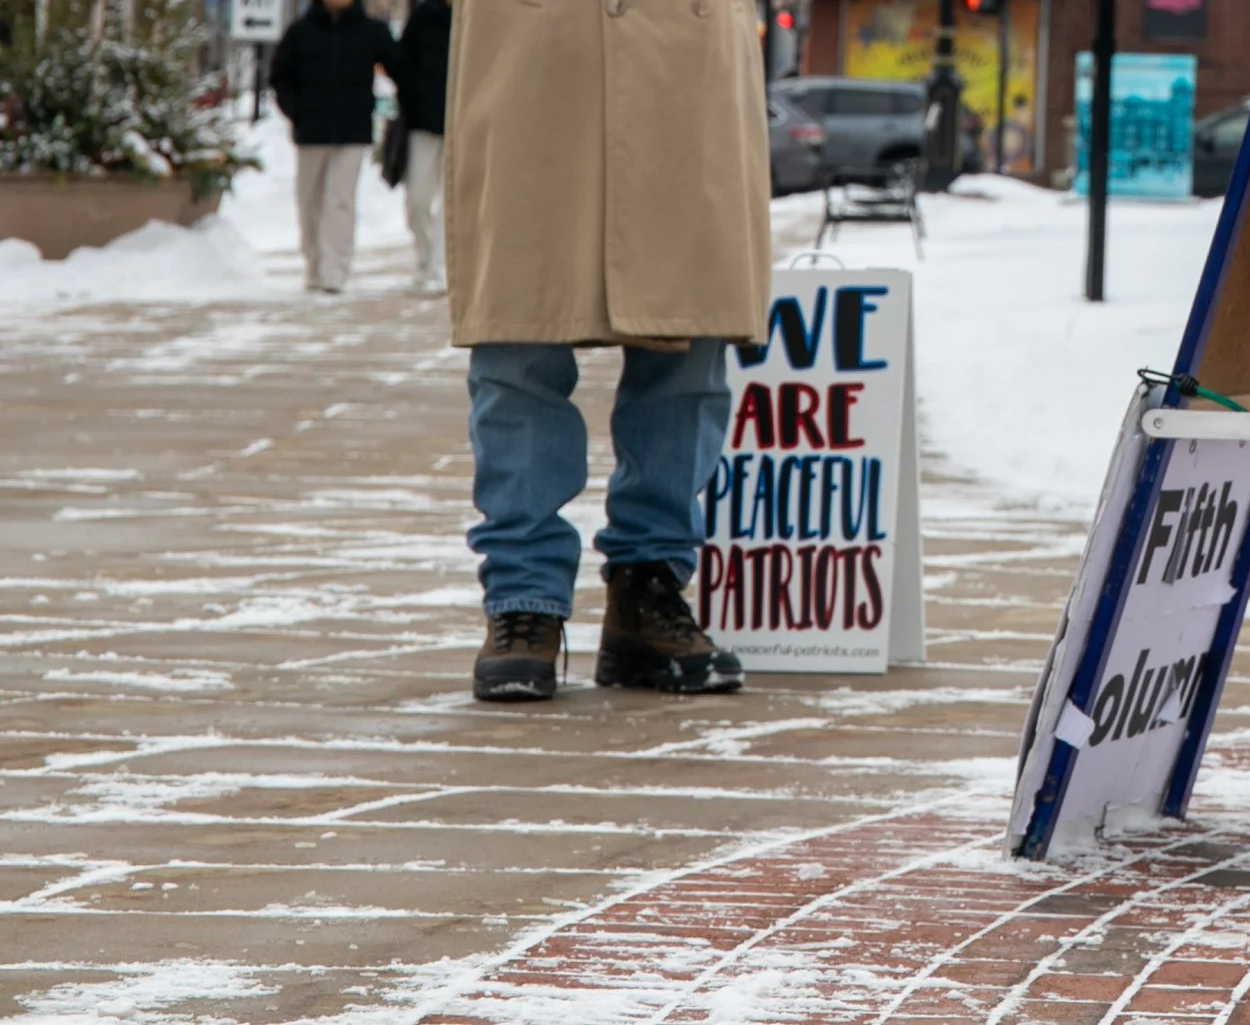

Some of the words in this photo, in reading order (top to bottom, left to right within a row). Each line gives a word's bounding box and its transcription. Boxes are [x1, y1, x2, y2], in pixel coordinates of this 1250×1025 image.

[736, 286, 888, 372] WE
[732, 381, 866, 451] ARE
[706, 453, 886, 542] PEACEFUL
[1136, 480, 1238, 586] Fifth
[699, 542, 884, 632] PATRIOTS
